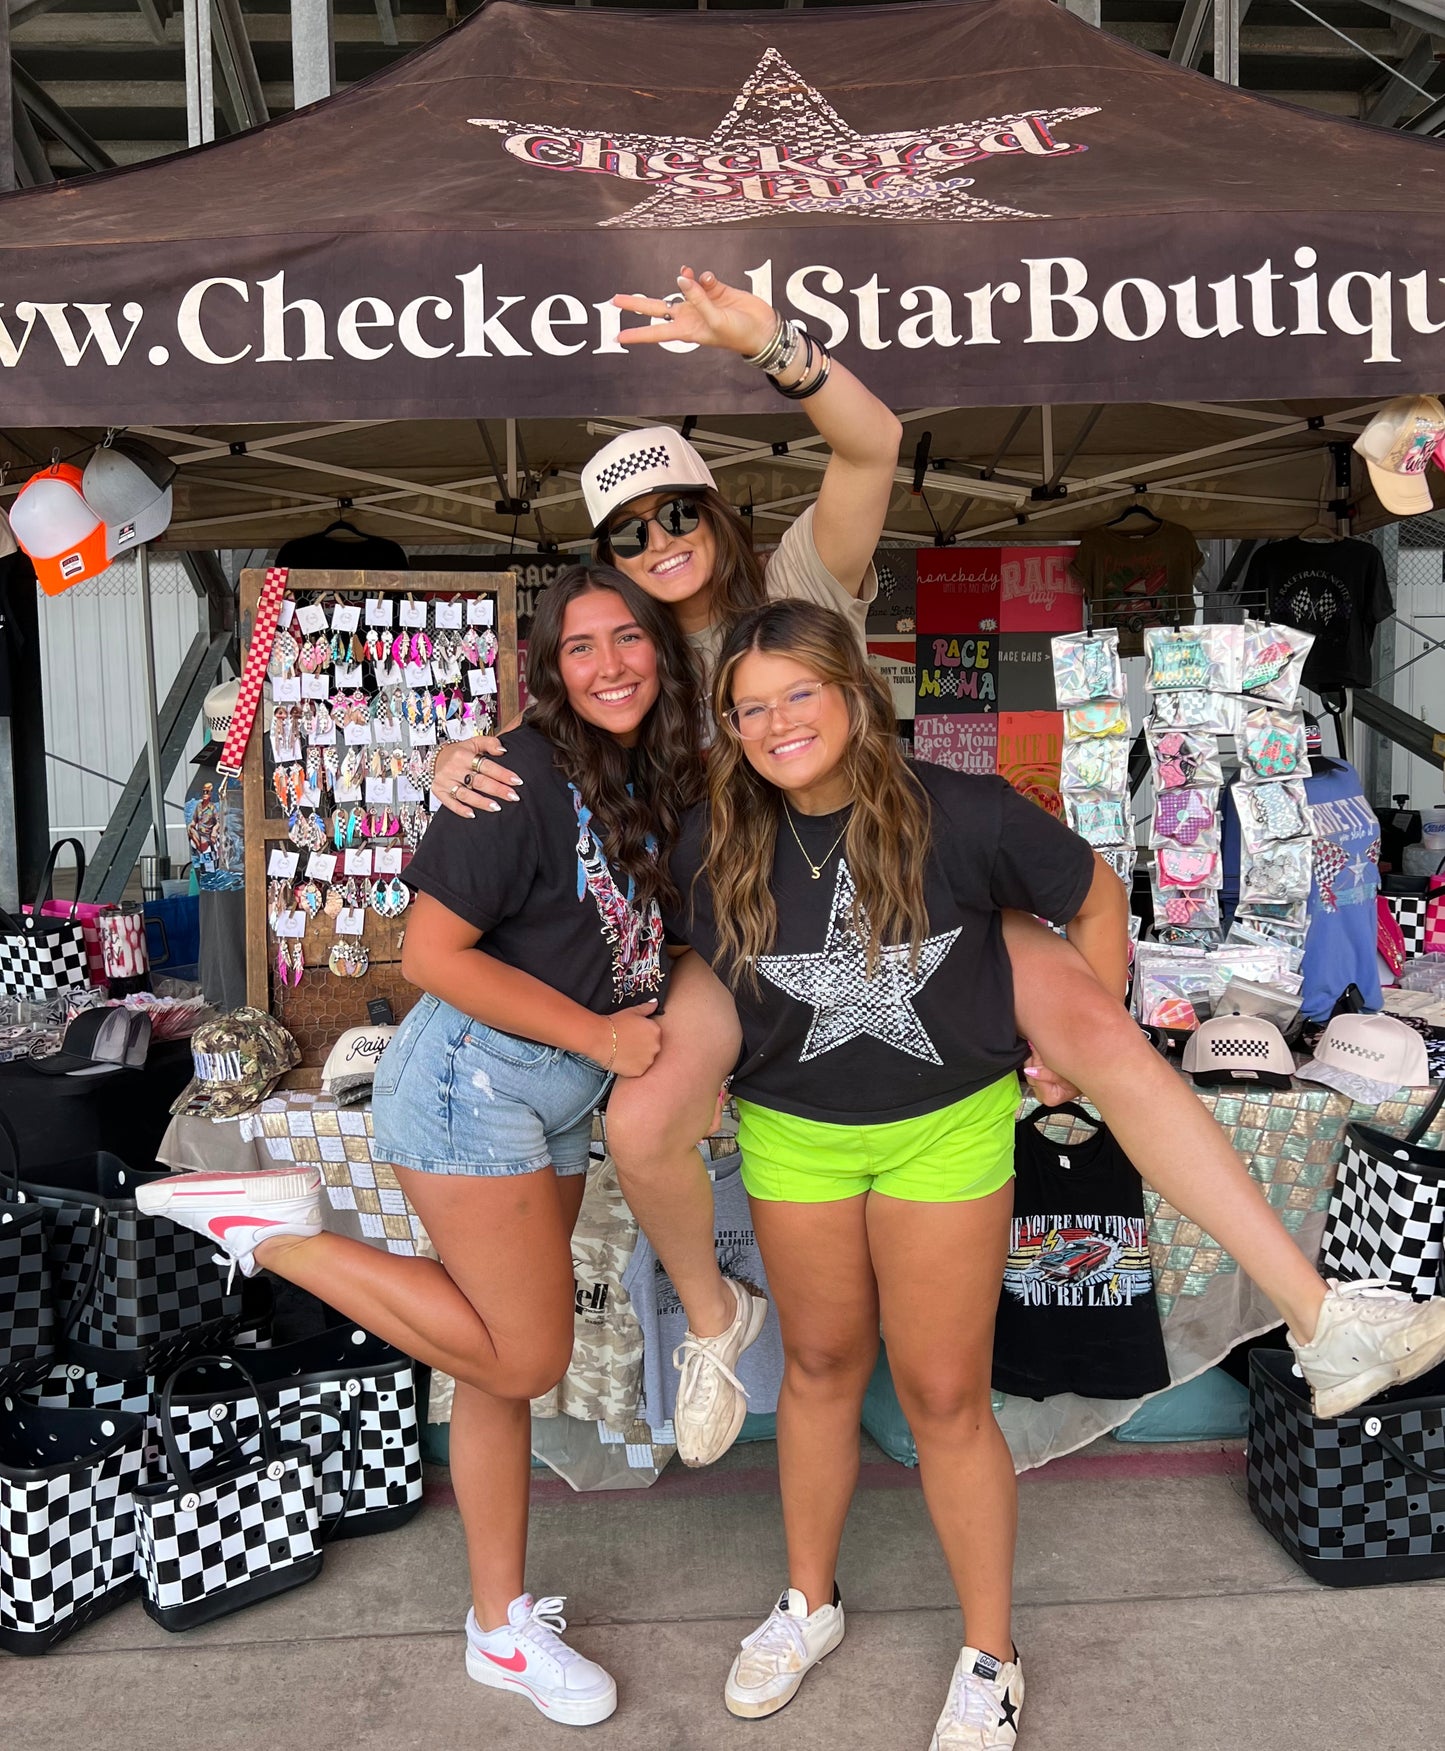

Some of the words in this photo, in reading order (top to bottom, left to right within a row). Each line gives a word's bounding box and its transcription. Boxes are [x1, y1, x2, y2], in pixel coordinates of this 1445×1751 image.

[502, 116, 1080, 183] Checkered
[670, 164, 906, 202] Star
[786, 177, 976, 213] Boutique
[917, 567, 1000, 591] homebody
[1028, 590, 1057, 612] day
[932, 638, 990, 669] RACE
[881, 667, 897, 675] DON'T
[919, 719, 954, 736] The
[914, 735, 951, 753] Race
[957, 734, 997, 755] Mom
[950, 749, 995, 769] Club
[1009, 1217, 1023, 1256] IF
[1025, 1214, 1072, 1242] YOU'RE
[1075, 1214, 1101, 1232] NOT
[1104, 1215, 1145, 1255] FIRST
[574, 1279, 608, 1310] ell
[1020, 1270, 1083, 1307] YOU'RE
[1088, 1274, 1136, 1307] LAST
